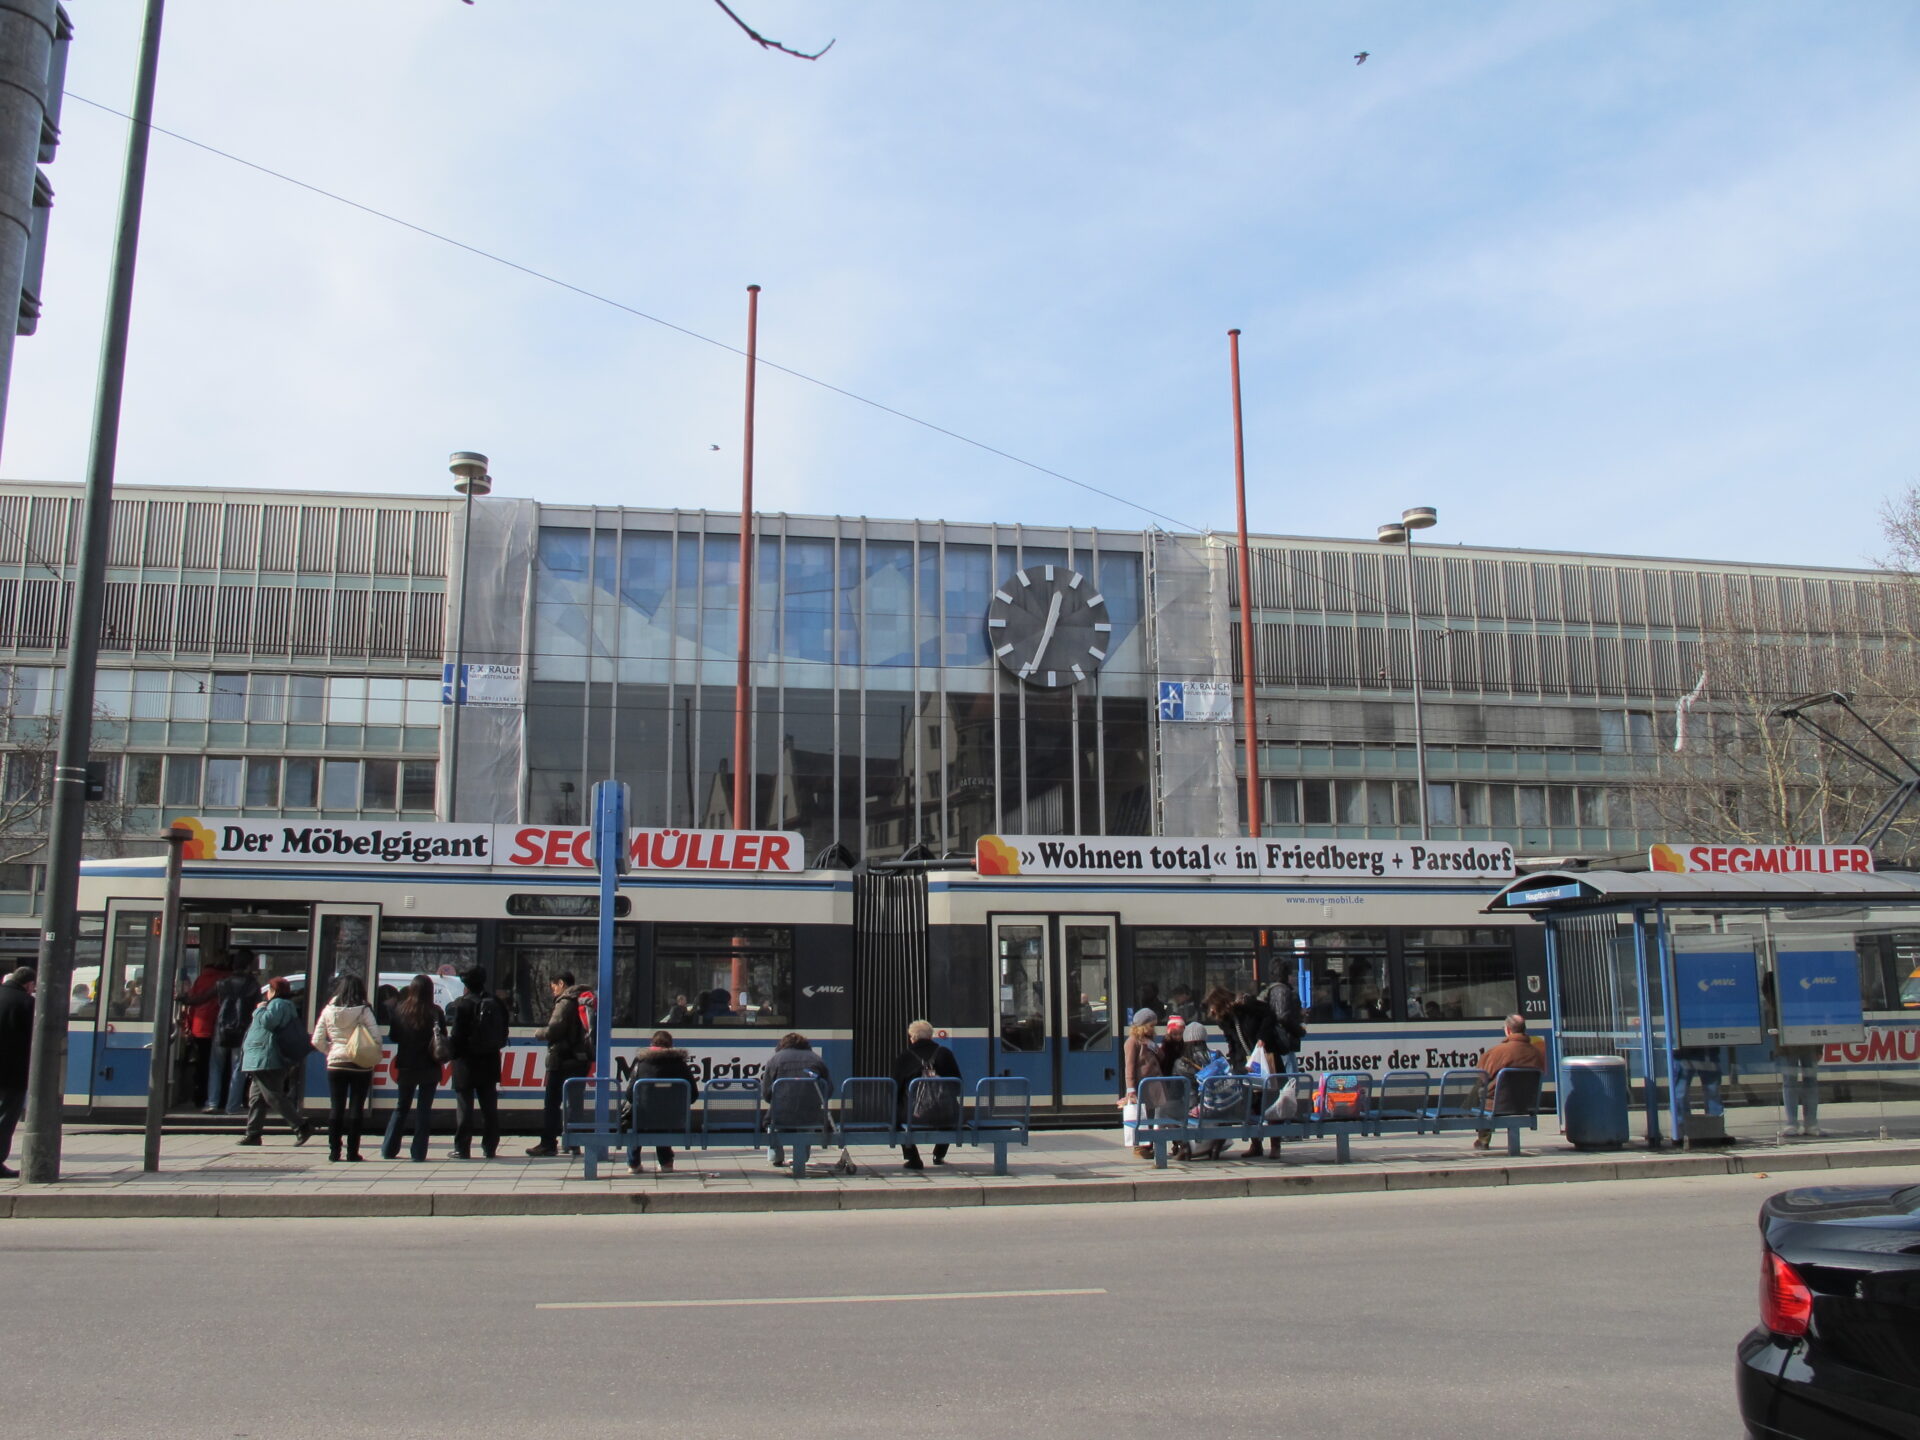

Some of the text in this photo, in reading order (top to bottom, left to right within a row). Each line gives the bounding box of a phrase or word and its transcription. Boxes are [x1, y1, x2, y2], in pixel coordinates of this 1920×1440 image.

[1199, 683, 1230, 691] RAUCH
[221, 826, 488, 862] Der Möbelgigant
[1236, 846, 1258, 869] in
[1266, 844, 1385, 876] Friedberg
[1410, 846, 1512, 871] Parsdorf
[1689, 845, 1870, 873] SEGMÜLLER
[1286, 896, 1365, 905] www.mvg-mobil.de
[1525, 889, 1560, 902] Hauptbahnhof
[815, 985, 845, 993] MVG
[1525, 1000, 1547, 1012] 2111
[1388, 1049, 1420, 1069] der
[1425, 1047, 1485, 1068] Extra
